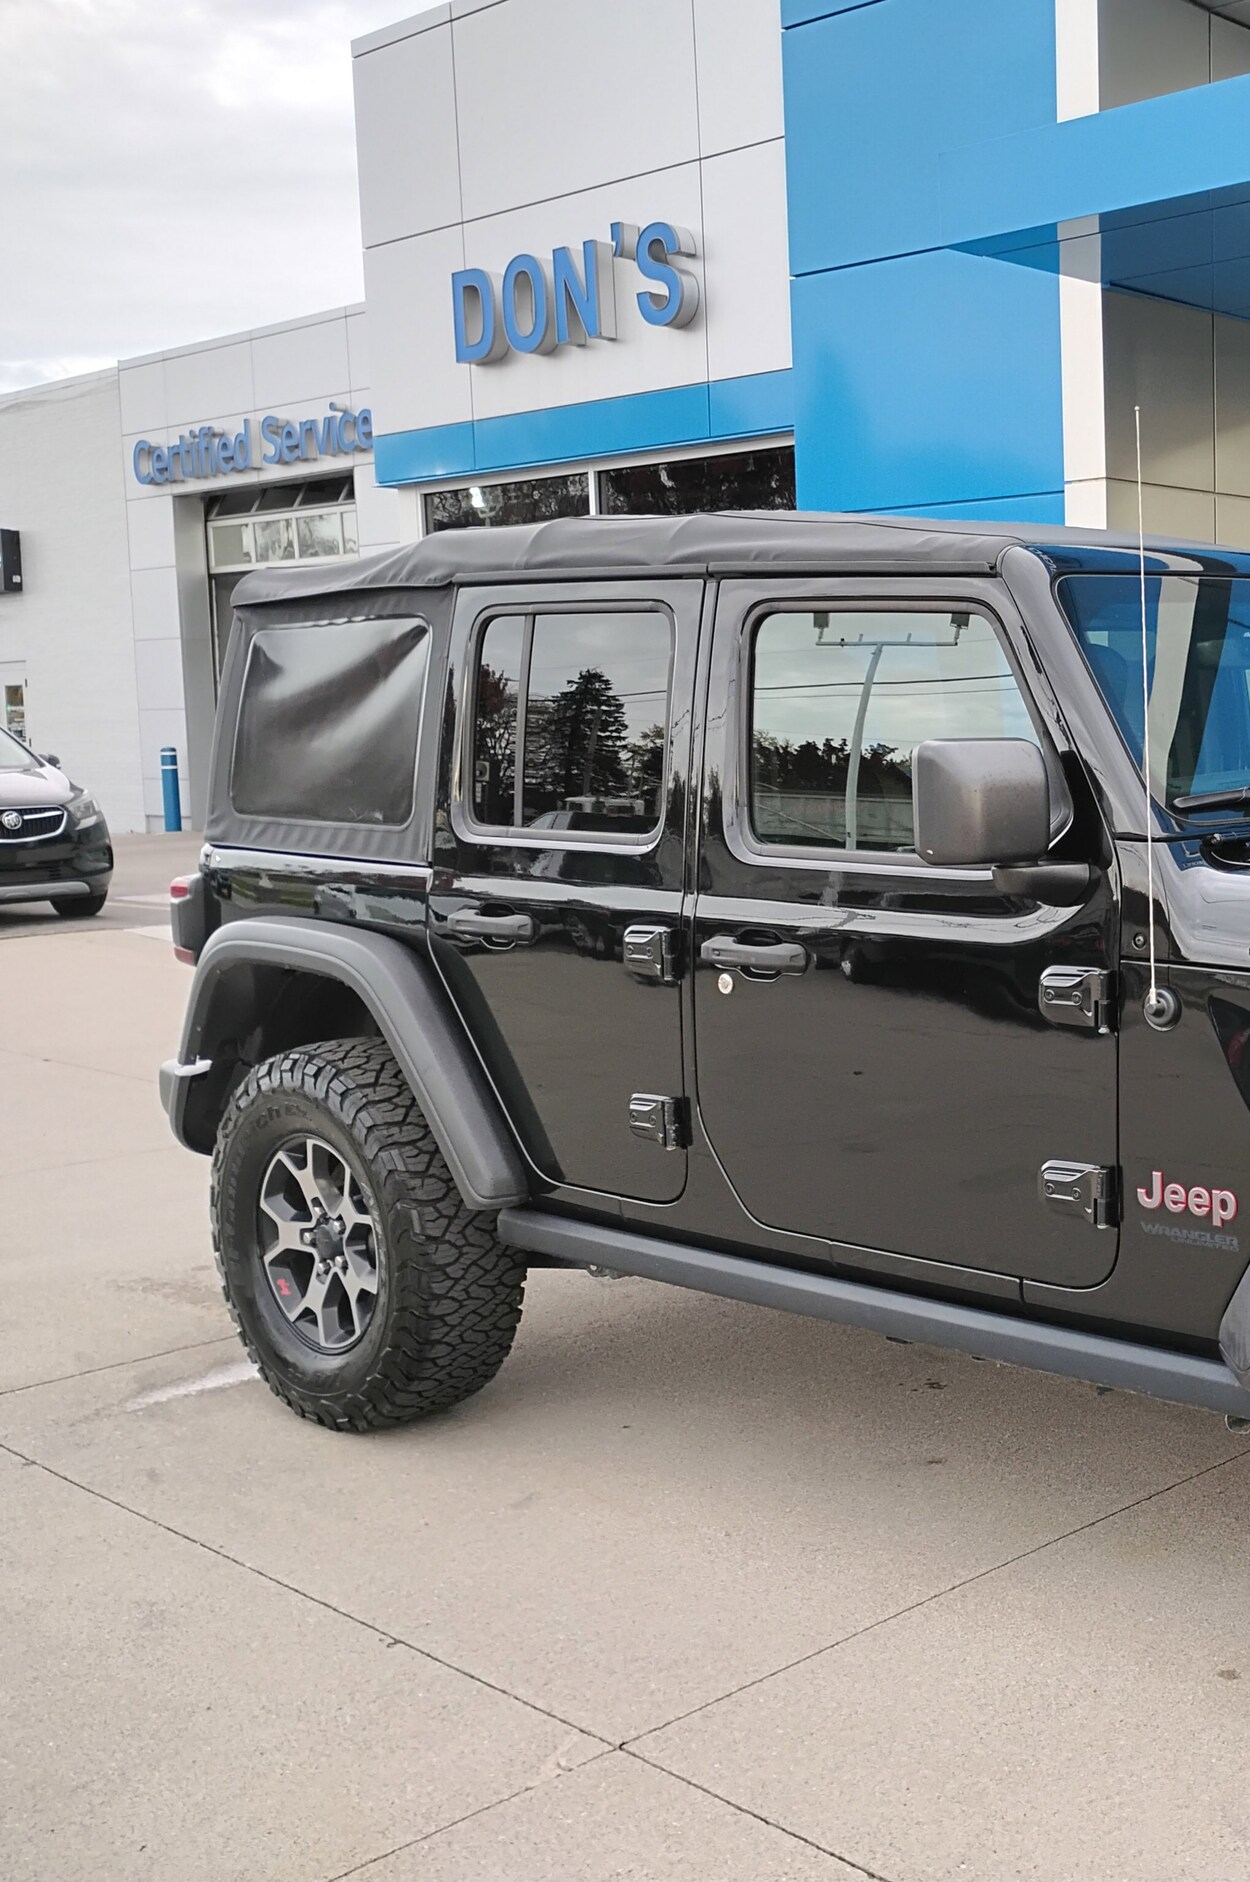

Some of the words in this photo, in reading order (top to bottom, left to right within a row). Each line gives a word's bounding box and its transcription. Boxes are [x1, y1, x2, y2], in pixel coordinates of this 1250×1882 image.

[452, 221, 699, 364] DON'S
[133, 418, 254, 485] Certified
[261, 401, 374, 465] Service
[1136, 1170, 1238, 1228] Jeep
[1140, 1221, 1240, 1246] WRANGLER
